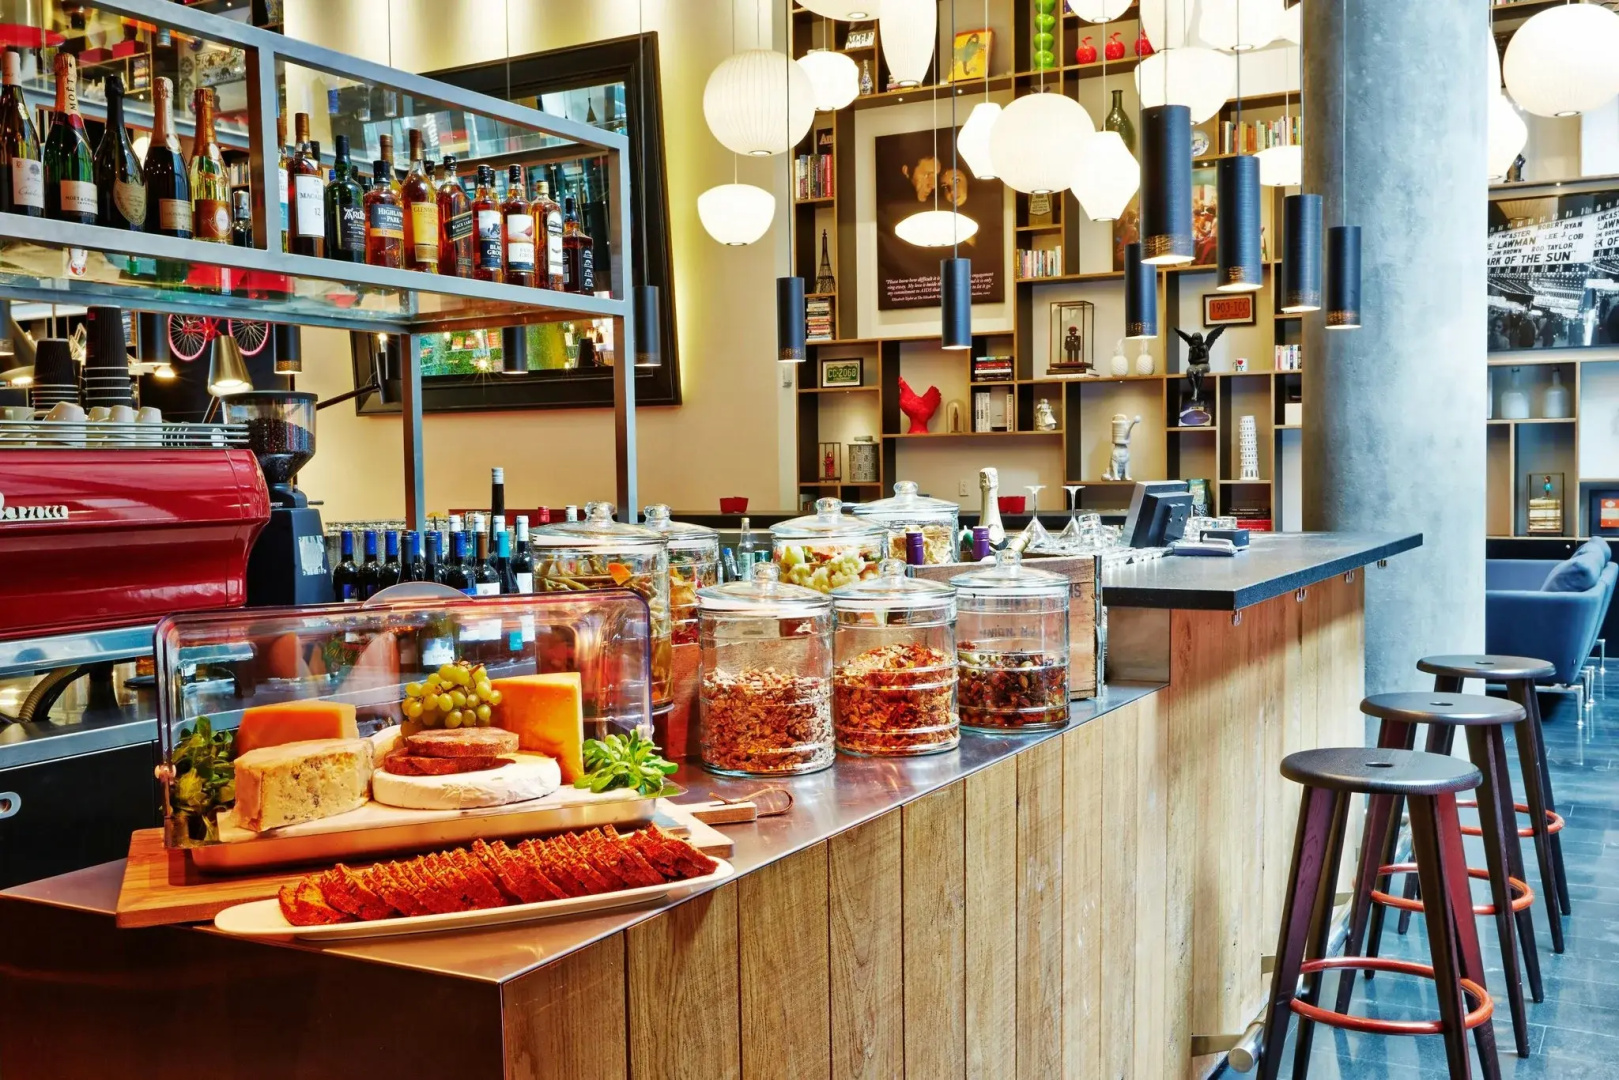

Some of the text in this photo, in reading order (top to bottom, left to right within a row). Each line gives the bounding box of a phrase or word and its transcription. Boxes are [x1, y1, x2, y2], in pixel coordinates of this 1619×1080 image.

[387, 216, 400, 224] PARK
[1538, 221, 1583, 231] ROBERT RYAN
[1497, 237, 1537, 249] LAWMAN
[1547, 242, 1573, 251] TAYLOR
[1504, 255, 1517, 265] OF
[1521, 254, 1541, 263] THE
